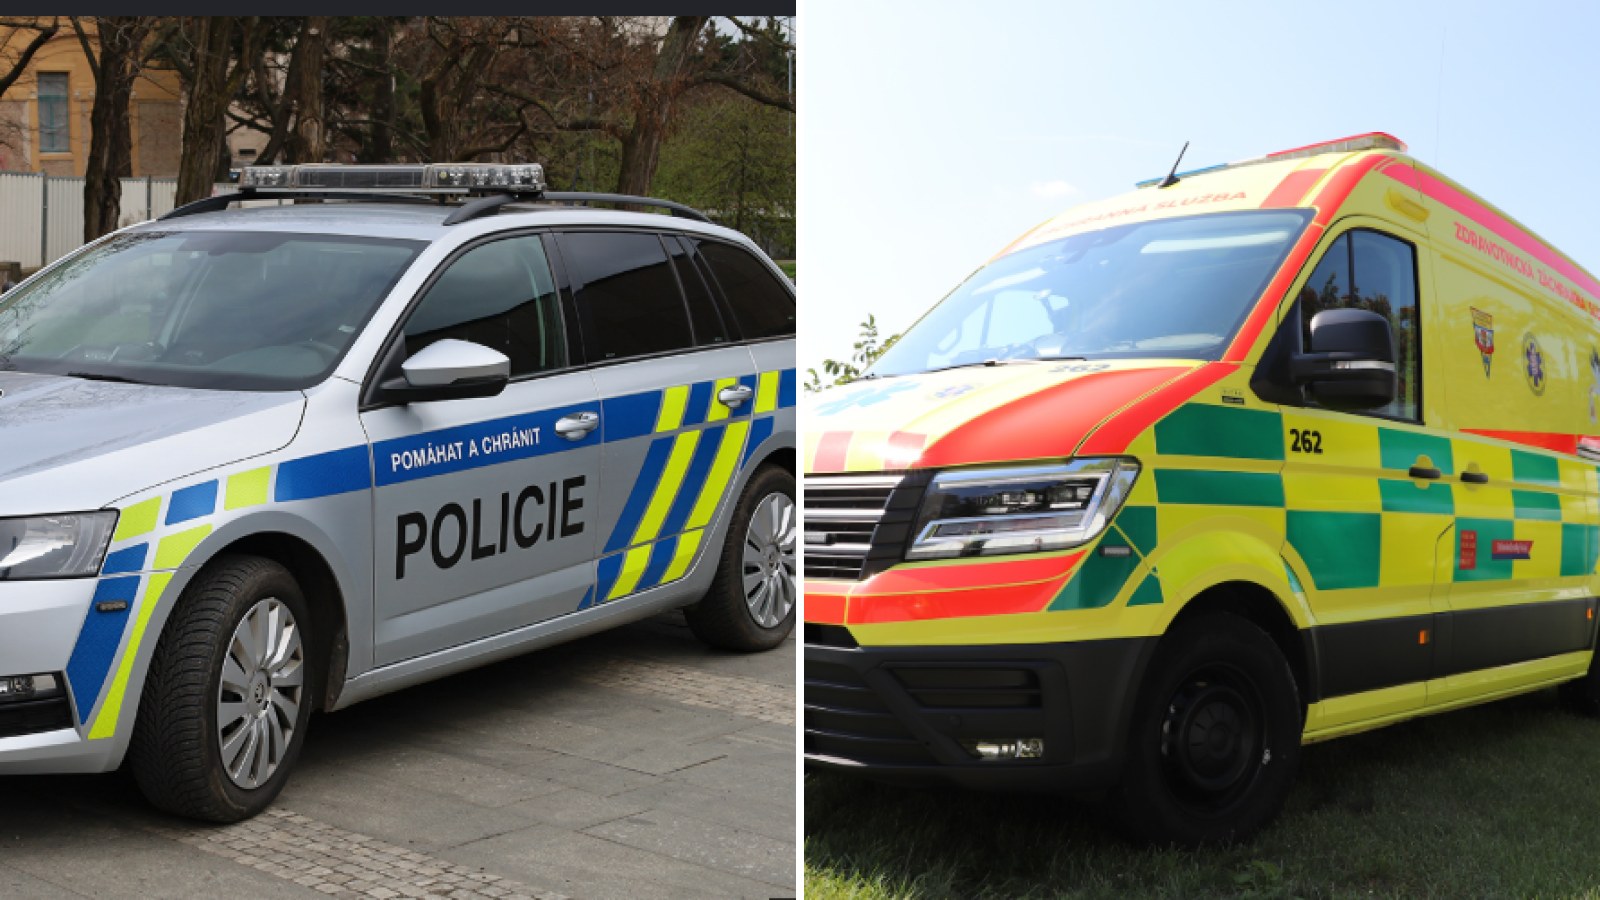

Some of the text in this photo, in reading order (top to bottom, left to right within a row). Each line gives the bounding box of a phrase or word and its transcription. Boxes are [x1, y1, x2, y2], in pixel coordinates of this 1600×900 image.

[390, 426, 541, 472] POMÁHAT A CHRÁNIT
[1289, 428, 1324, 454] 262
[395, 474, 586, 580] POLICIE
